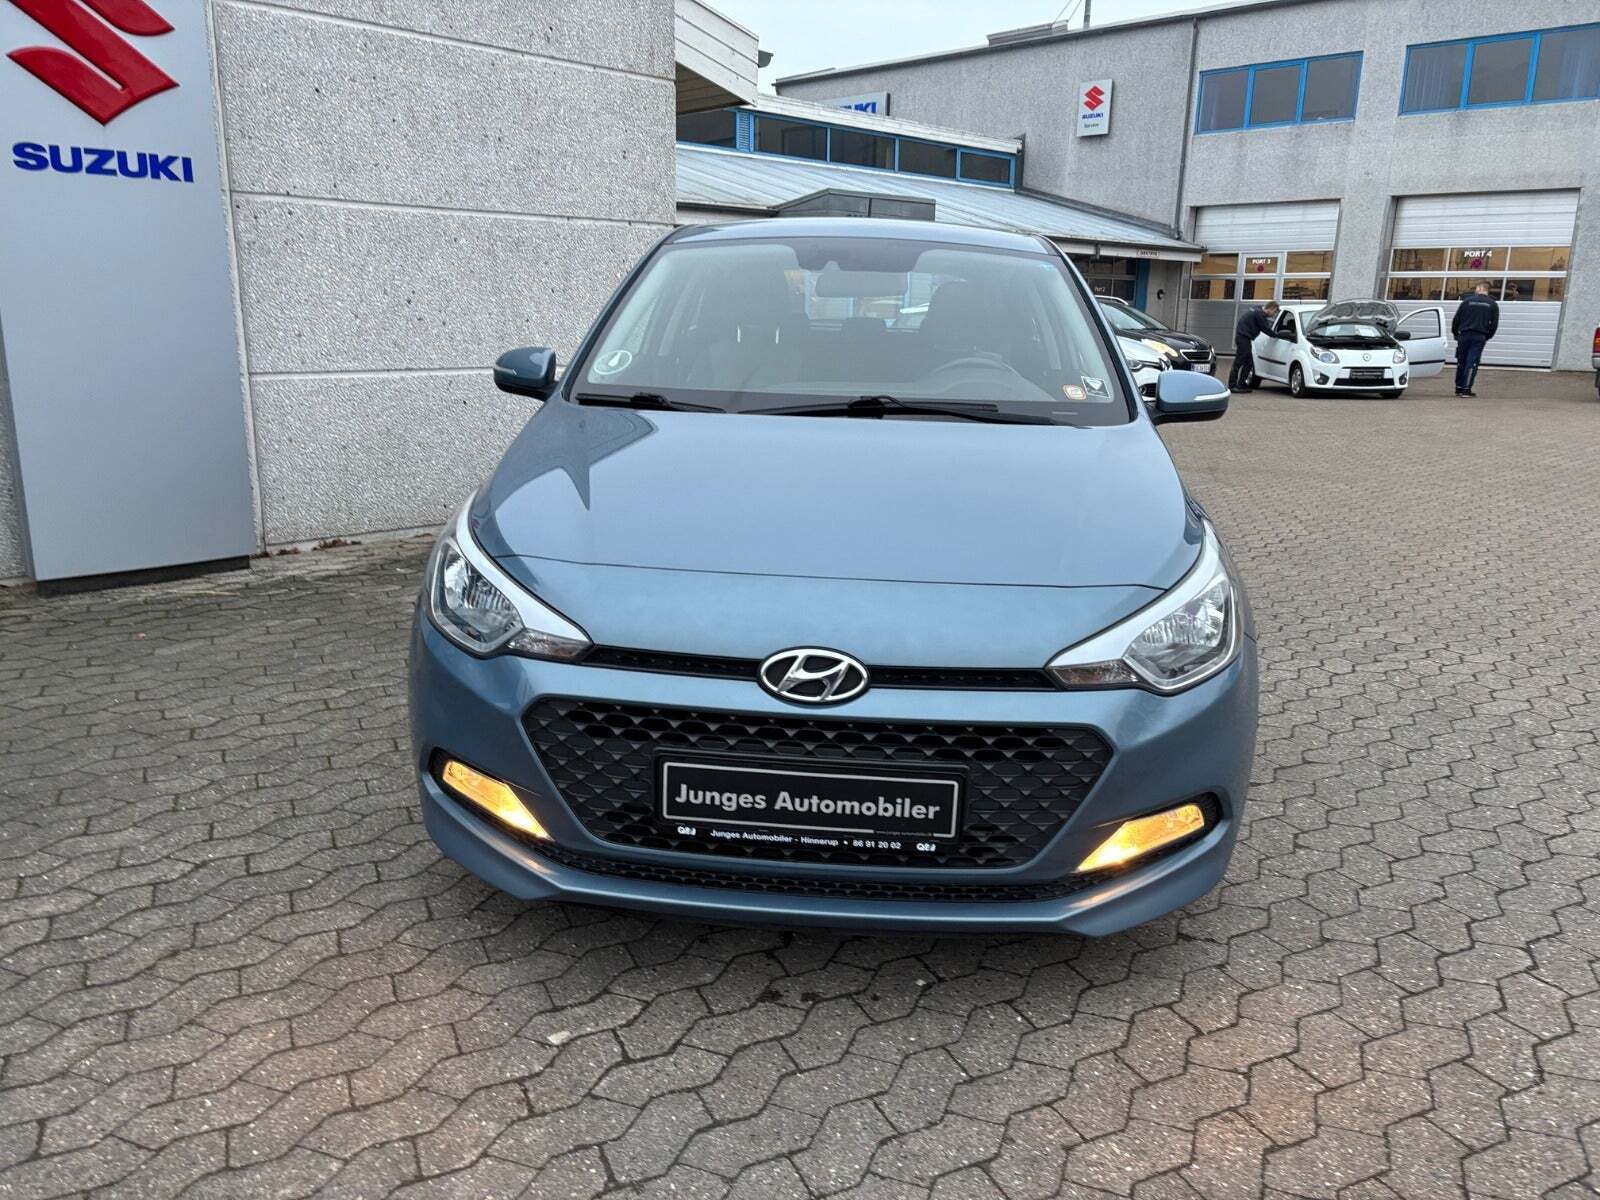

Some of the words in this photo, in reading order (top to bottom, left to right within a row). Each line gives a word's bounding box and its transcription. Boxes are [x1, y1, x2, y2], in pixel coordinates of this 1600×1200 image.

[1082, 112, 1104, 120] SUZUKI
[12, 142, 194, 183] SUZUKI
[1464, 250, 1485, 258] PORT
[675, 783, 767, 812] Junges
[774, 791, 940, 820] Automobiler
[710, 829, 740, 840] Junges
[742, 832, 793, 843] Automobiler
[800, 836, 839, 847] Hinnerup
[877, 841, 889, 849] 20
